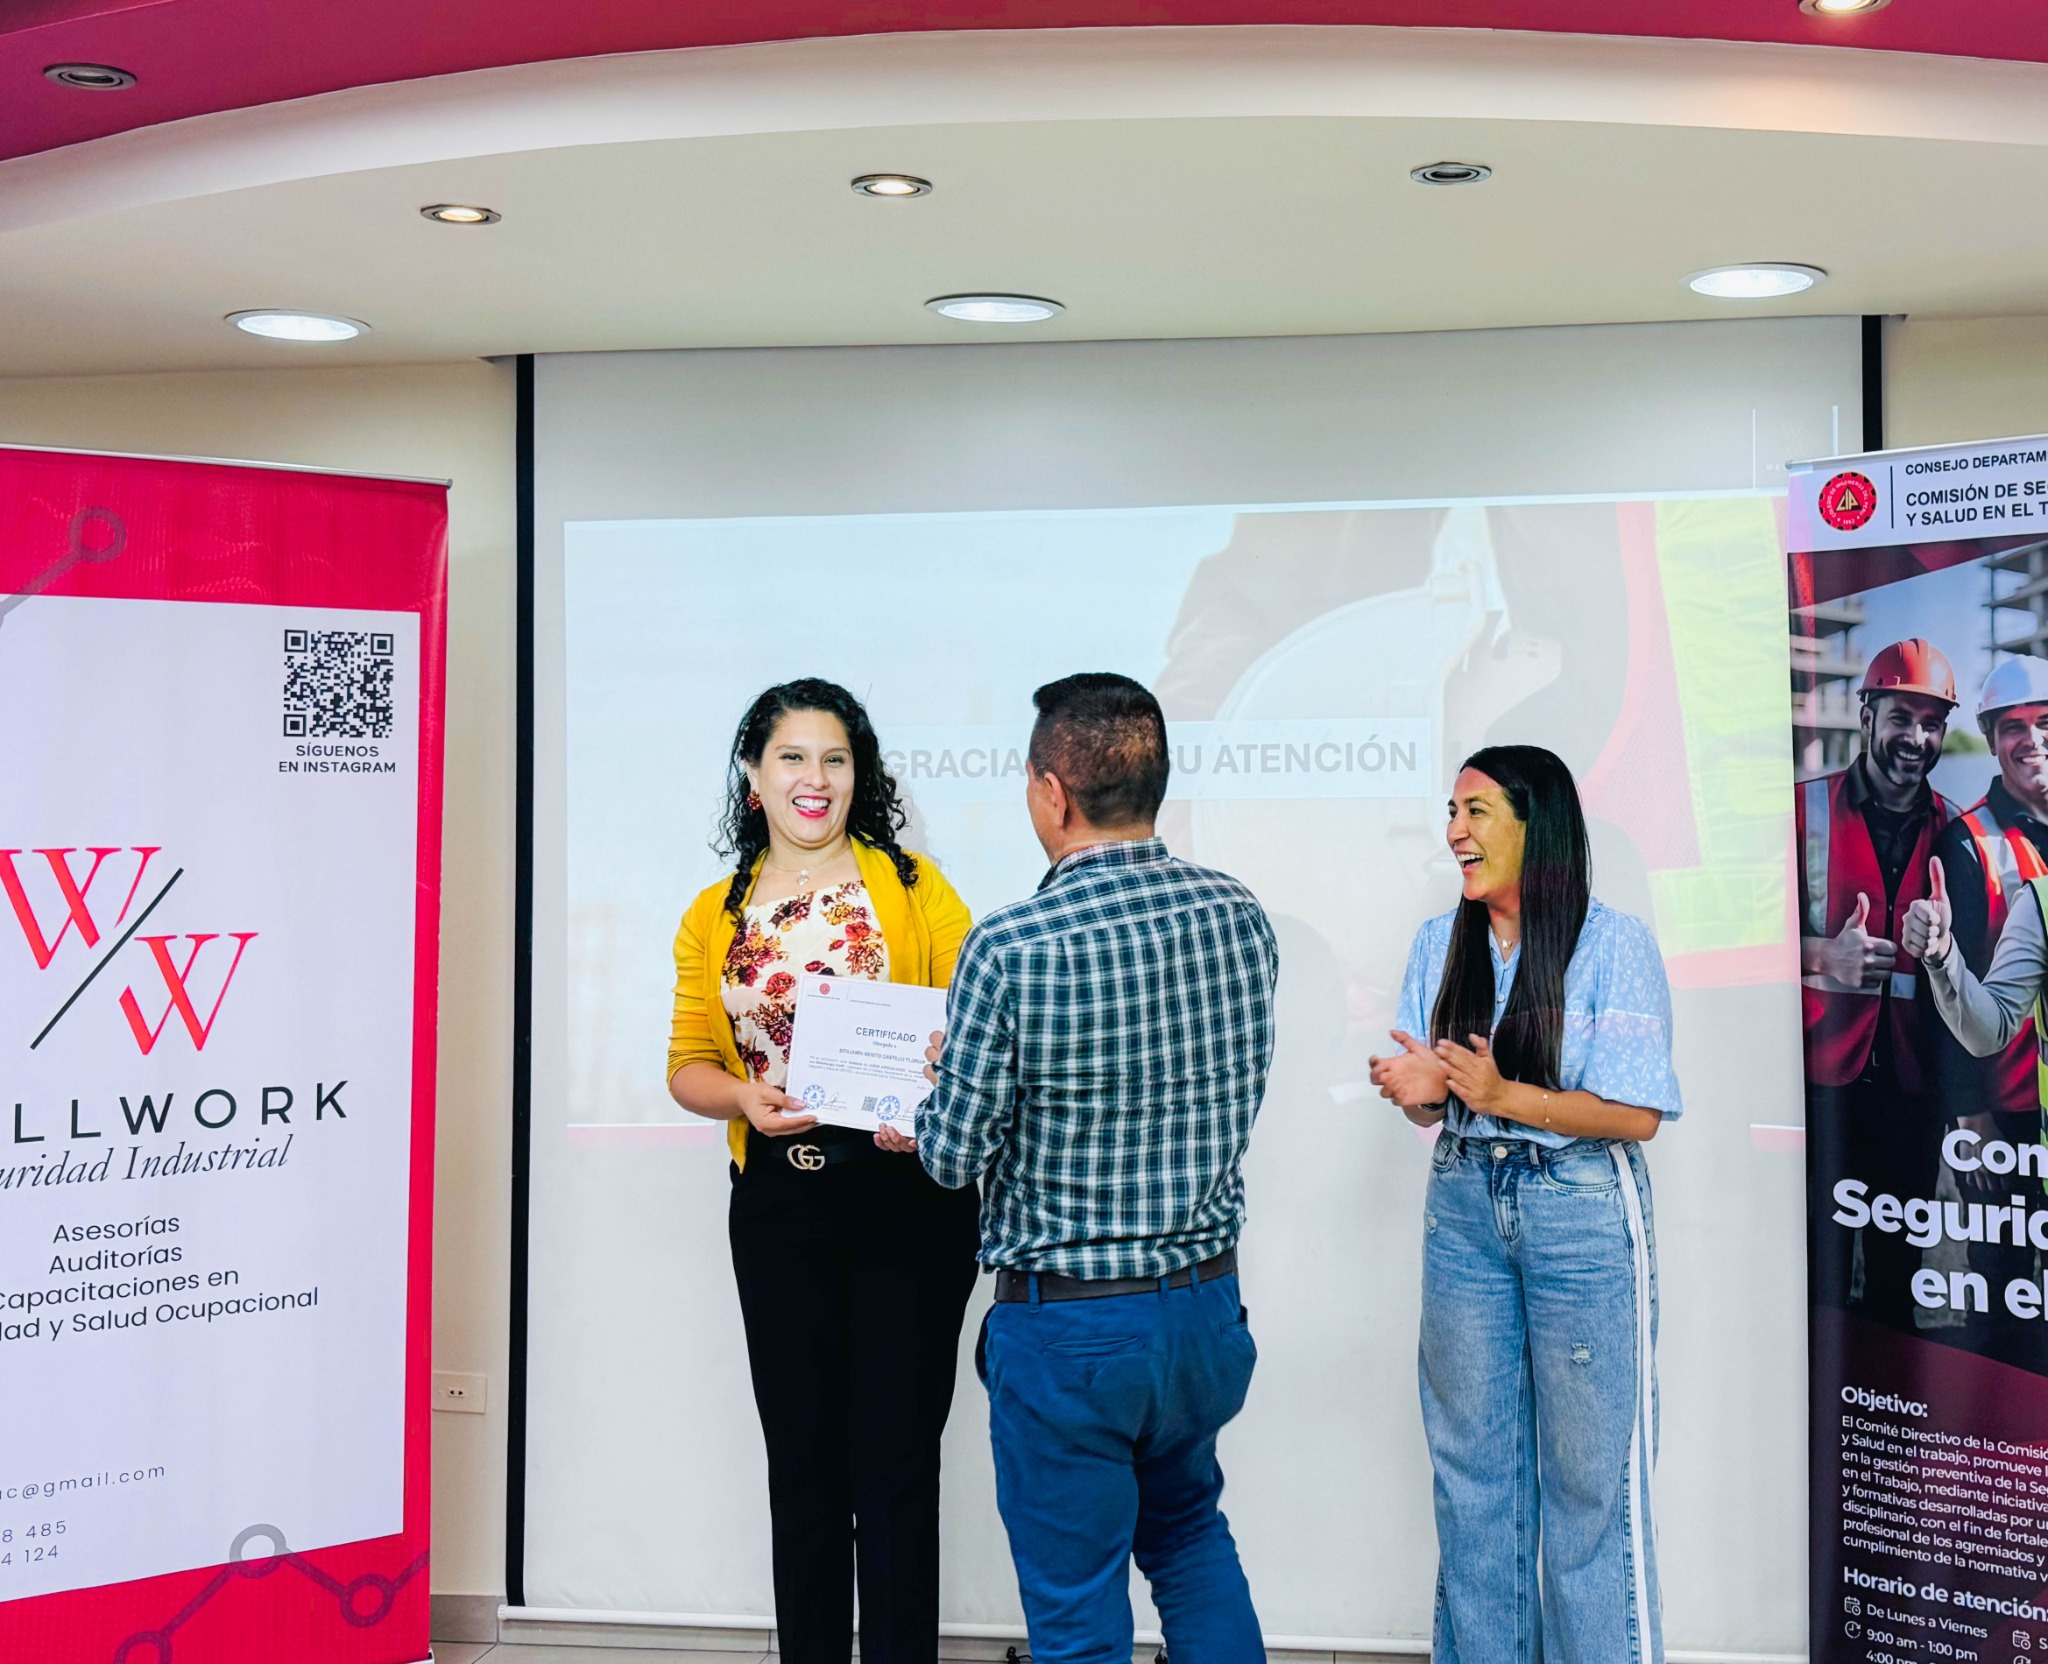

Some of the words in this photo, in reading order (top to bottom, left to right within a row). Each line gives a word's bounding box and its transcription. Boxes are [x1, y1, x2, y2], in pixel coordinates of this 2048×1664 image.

[1905, 458, 1969, 475] CONSEJO
[1972, 450, 2047, 469] DEPARTAM
[1906, 484, 1989, 507] COMISIÓN
[1995, 484, 2018, 498] DE
[2023, 480, 2048, 495] SE
[1906, 513, 1917, 526] Y
[1921, 508, 1978, 526] SALUD
[1983, 505, 2006, 519] EN
[2011, 503, 2034, 517] EL
[278, 761, 300, 773] EN
[303, 761, 396, 773] INSTAGRAM
[296, 742, 380, 757] SÍGUENOS
[1168, 745, 1202, 775] U
[1212, 734, 1417, 774] ATENCIÓN
[856, 1027, 917, 1043] CERTIFICADO
[14, 1081, 349, 1144] LLWORK
[121, 1134, 294, 1181] Industrial
[1942, 1129, 2048, 1179] Con
[53, 1215, 180, 1244] Asesorías
[49, 1245, 183, 1275] Auditorías
[207, 1267, 240, 1288] en
[1911, 1268, 1989, 1313] en
[0, 1317, 39, 1342] ad
[49, 1319, 64, 1342] y
[72, 1306, 147, 1333] Salud
[155, 1287, 319, 1323] Ocupacional
[1841, 1386, 1928, 1418] Objetivo:
[1842, 1415, 1853, 1427] El
[1856, 1418, 1899, 1437] Comité
[1901, 1427, 1961, 1446] Directivo
[1963, 1435, 1981, 1449] de
[1983, 1438, 1995, 1451] la
[1841, 1434, 1849, 1446] y
[1852, 1433, 1885, 1450] Salud
[1887, 1443, 1903, 1455] en
[1905, 1445, 1917, 1457] el
[1920, 1447, 1971, 1466] trabajo,
[1973, 1456, 2042, 1477] promueve
[0, 1466, 165, 1500] c@gmail.com
[1842, 1451, 1858, 1463] en
[1860, 1451, 1870, 1465] la
[1873, 1457, 1919, 1475] gestión
[1922, 1466, 1992, 1486] preventiva
[1994, 1475, 2012, 1489] de
[2015, 1478, 2027, 1492] la
[2029, 1481, 2048, 1498] Se
[1842, 1467, 1858, 1479] en
[1860, 1470, 1871, 1482] el
[1873, 1472, 1921, 1494] Trabajo,
[1924, 1483, 1989, 1502] mediante
[1992, 1490, 2048, 1513] iniciativa
[1842, 1484, 1850, 1497] y
[1852, 1484, 1917, 1509] formativas
[1919, 1498, 2008, 1523] desarrolladas
[2010, 1515, 2033, 1527] por
[2036, 1518, 2048, 1530] u
[1842, 1500, 1918, 1528] disciplinario,
[1920, 1517, 1946, 1530] con
[1949, 1520, 1960, 1532] el
[1963, 1521, 1982, 1536] fin
[1984, 1526, 2002, 1540] de
[2, 1529, 13, 1543] 8
[26, 1520, 66, 1539] 485
[1843, 1518, 1910, 1542] profesional
[1912, 1531, 1930, 1545] de
[1933, 1533, 1953, 1548] los
[1955, 1539, 2035, 1563] agremiados
[2036, 1554, 2045, 1567] y
[1, 1552, 12, 1566] 4
[24, 1545, 58, 1563] 124
[1843, 1536, 1931, 1562] cumplimiento
[1933, 1551, 1952, 1565] de
[1954, 1553, 1966, 1567] la
[1968, 1559, 2037, 1581] normativa
[1844, 1566, 1917, 1598] Horario
[1920, 1582, 1948, 1603] de
[1867, 1604, 1884, 1618] De
[1887, 1608, 1925, 1627] Lunes
[1928, 1619, 1936, 1628] a
[1938, 1617, 1988, 1639] Viernes
[1866, 1649, 1894, 1664] 4:00
[1867, 1628, 1894, 1645] 9:00
[1896, 1637, 1917, 1650] am
[1927, 1640, 1953, 1656] 1:00
[1956, 1649, 1978, 1662] pm
